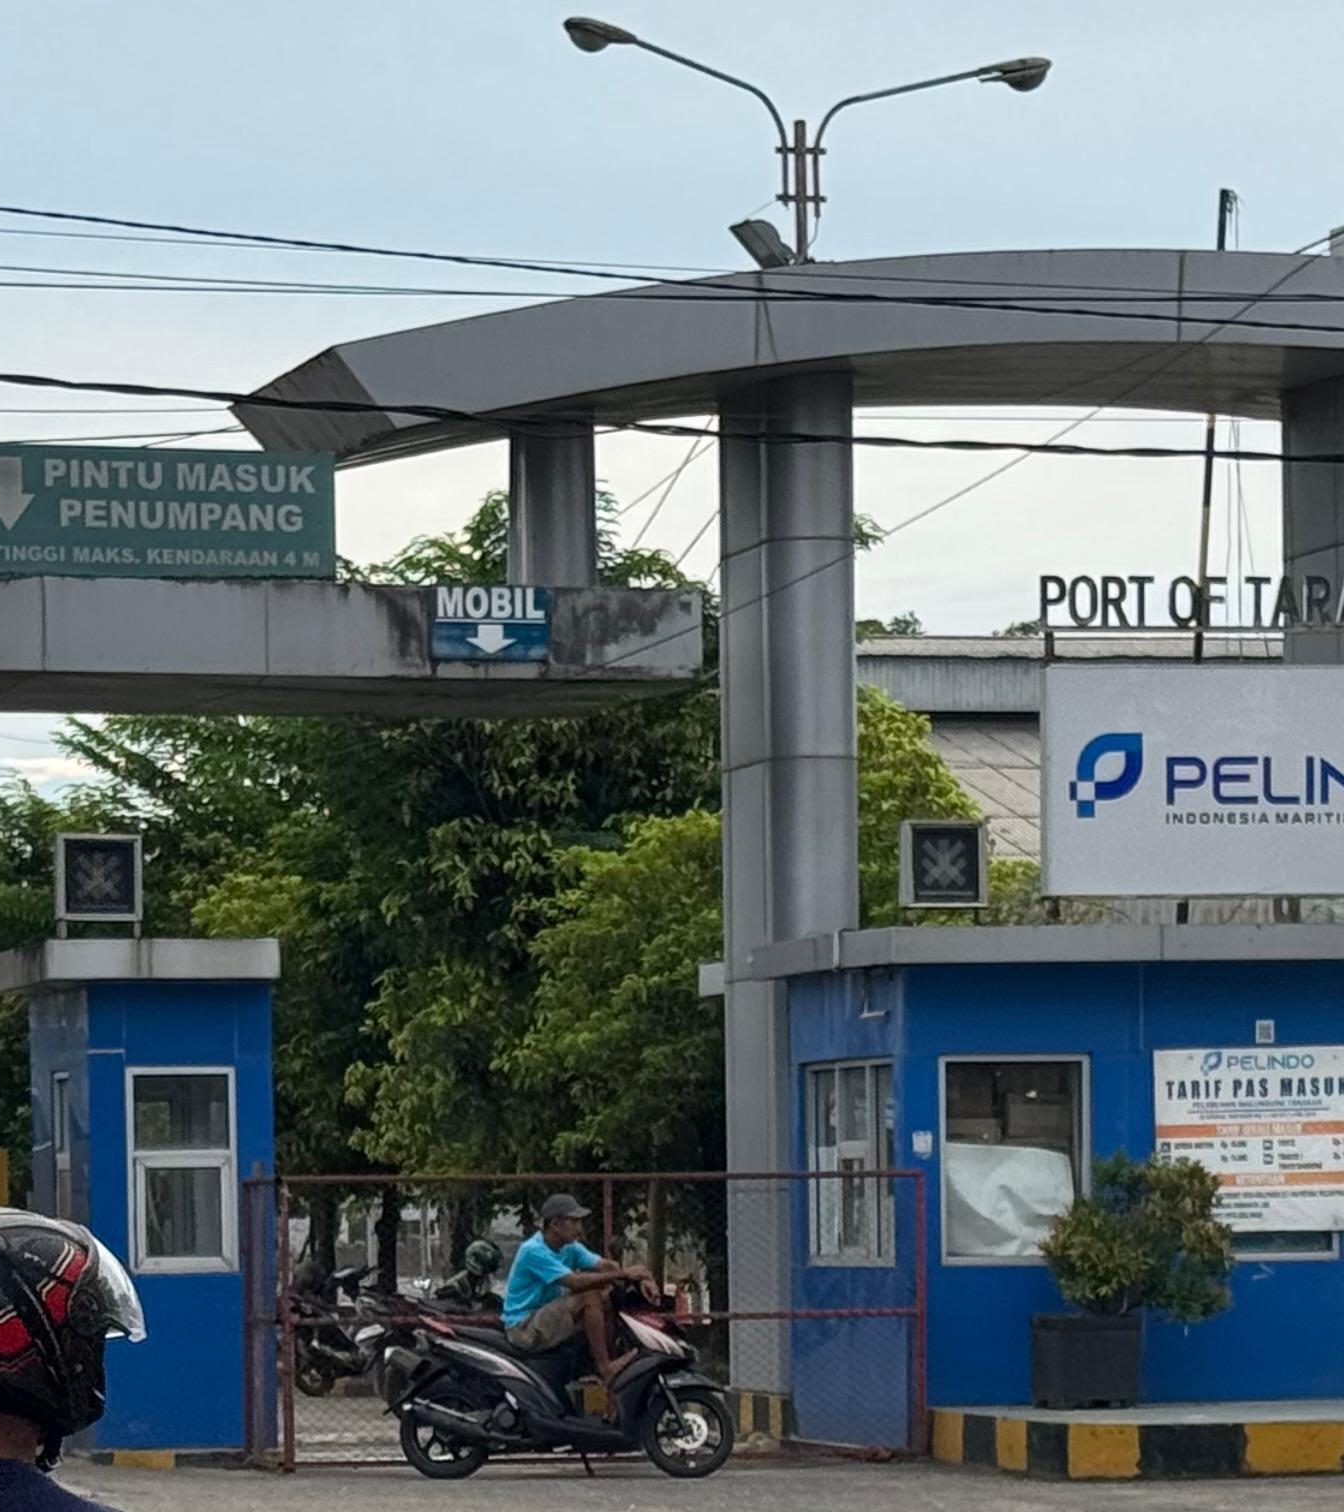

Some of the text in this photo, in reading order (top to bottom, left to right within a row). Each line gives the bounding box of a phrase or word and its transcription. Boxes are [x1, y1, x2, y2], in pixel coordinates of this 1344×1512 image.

[44, 458, 316, 495] PINTU MASUK
[59, 499, 304, 532] PENUMPANG
[73, 547, 140, 564] MAKS.
[147, 548, 278, 566] KENDARAAN
[282, 552, 296, 567] 4
[303, 552, 320, 567] M
[437, 586, 545, 620] MOBIL
[1040, 575, 1154, 627] PORT
[1169, 576, 1227, 627] OF
[1166, 812, 1269, 825] INDONESIA
[1227, 1054, 1315, 1071] PELINDO
[1166, 1080, 1222, 1100] TARIF
[1233, 1078, 1269, 1098] PAS
